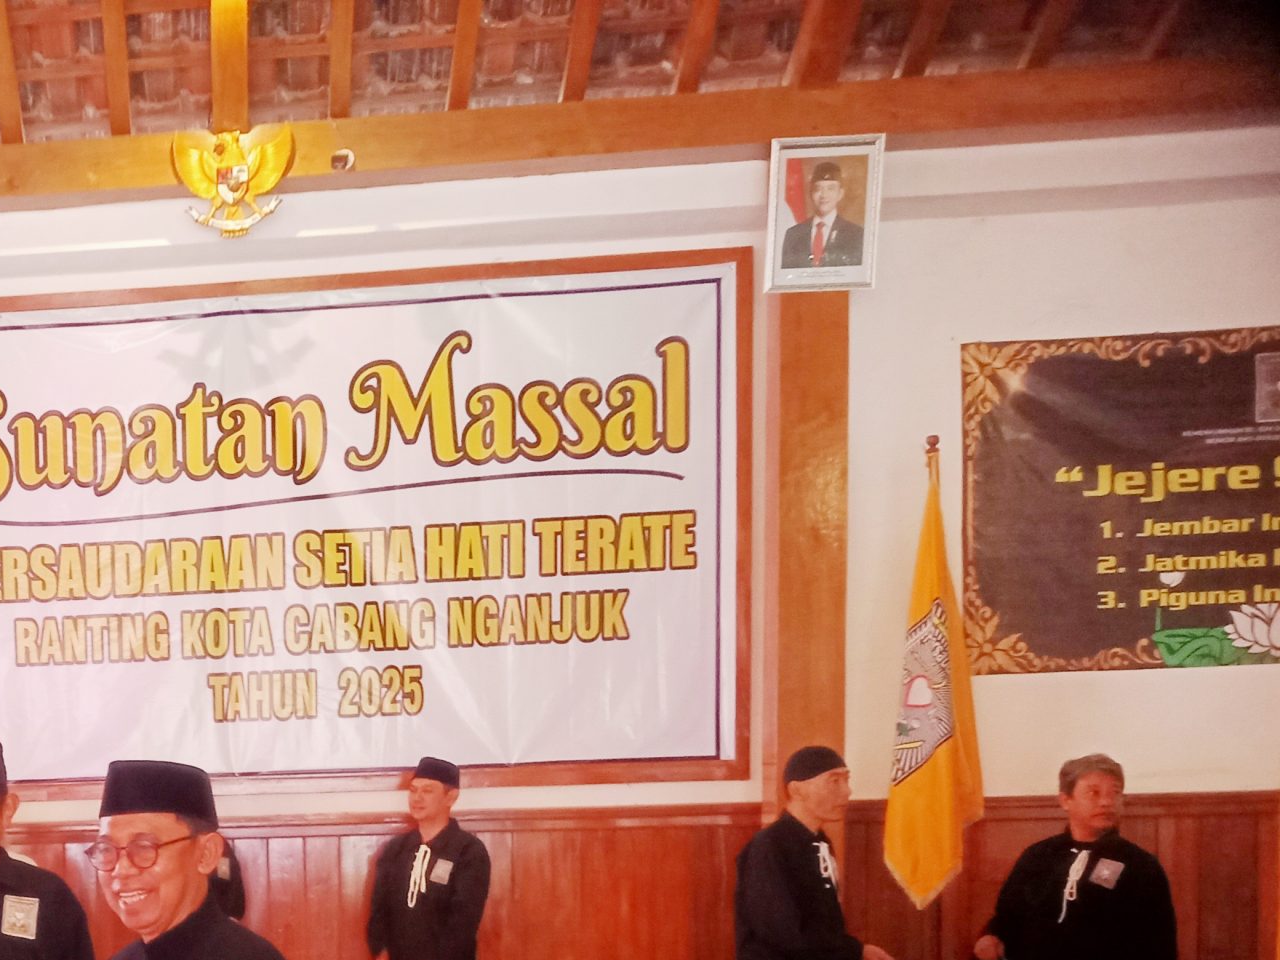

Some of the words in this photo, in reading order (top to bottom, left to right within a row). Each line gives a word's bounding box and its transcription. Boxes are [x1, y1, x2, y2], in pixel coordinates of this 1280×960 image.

[344, 330, 690, 471] Massal
[293, 526, 418, 589] SETIA
[424, 519, 525, 583] HATI
[533, 510, 697, 577] TERATE
[1099, 520, 1124, 539] 1.
[1136, 515, 1255, 537] Jembar
[1096, 555, 1126, 574] 2.
[1138, 550, 1267, 573] Jatmika
[15, 610, 170, 667] RANTING
[181, 606, 274, 660] KOTA
[284, 597, 436, 655] CABANG
[447, 588, 630, 648] NGANJUK
[1096, 590, 1126, 609] 3.
[1139, 587, 1246, 611] Piguna
[208, 668, 318, 723] TAHUN
[337, 665, 425, 718] 2025
